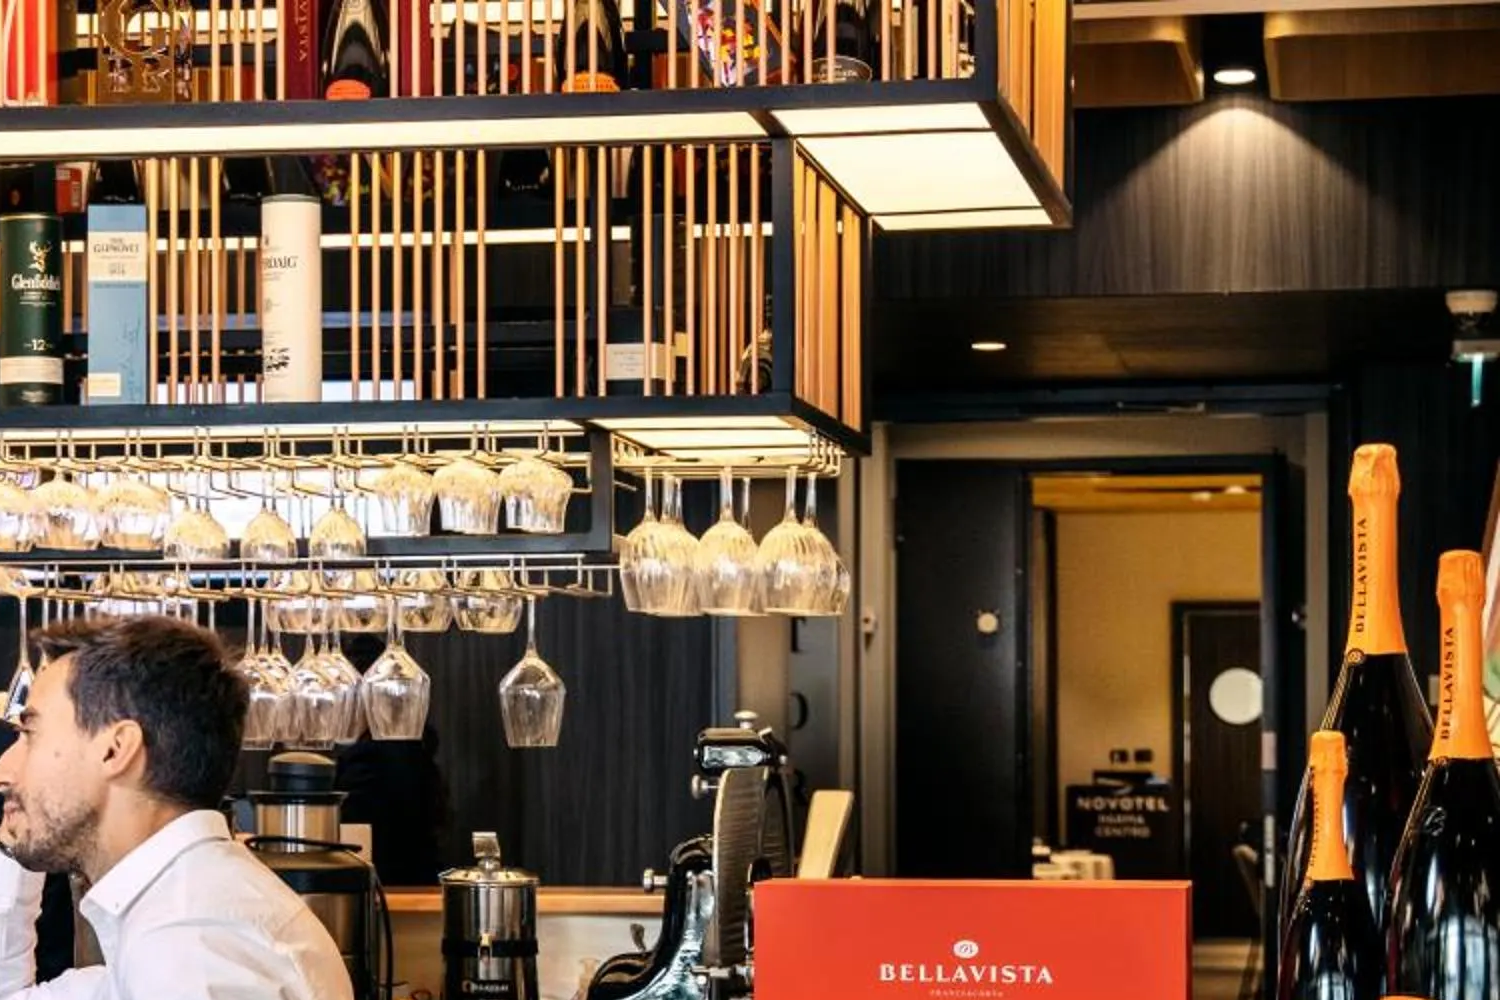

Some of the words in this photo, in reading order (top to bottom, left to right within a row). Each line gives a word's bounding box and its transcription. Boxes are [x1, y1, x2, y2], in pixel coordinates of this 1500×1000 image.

[1355, 518, 1368, 633] BELLAVISTA
[1440, 627, 1454, 740] BELLAVISTA
[1077, 796, 1170, 812] NOVOTEL
[879, 963, 1053, 984] BELLAVISTA
